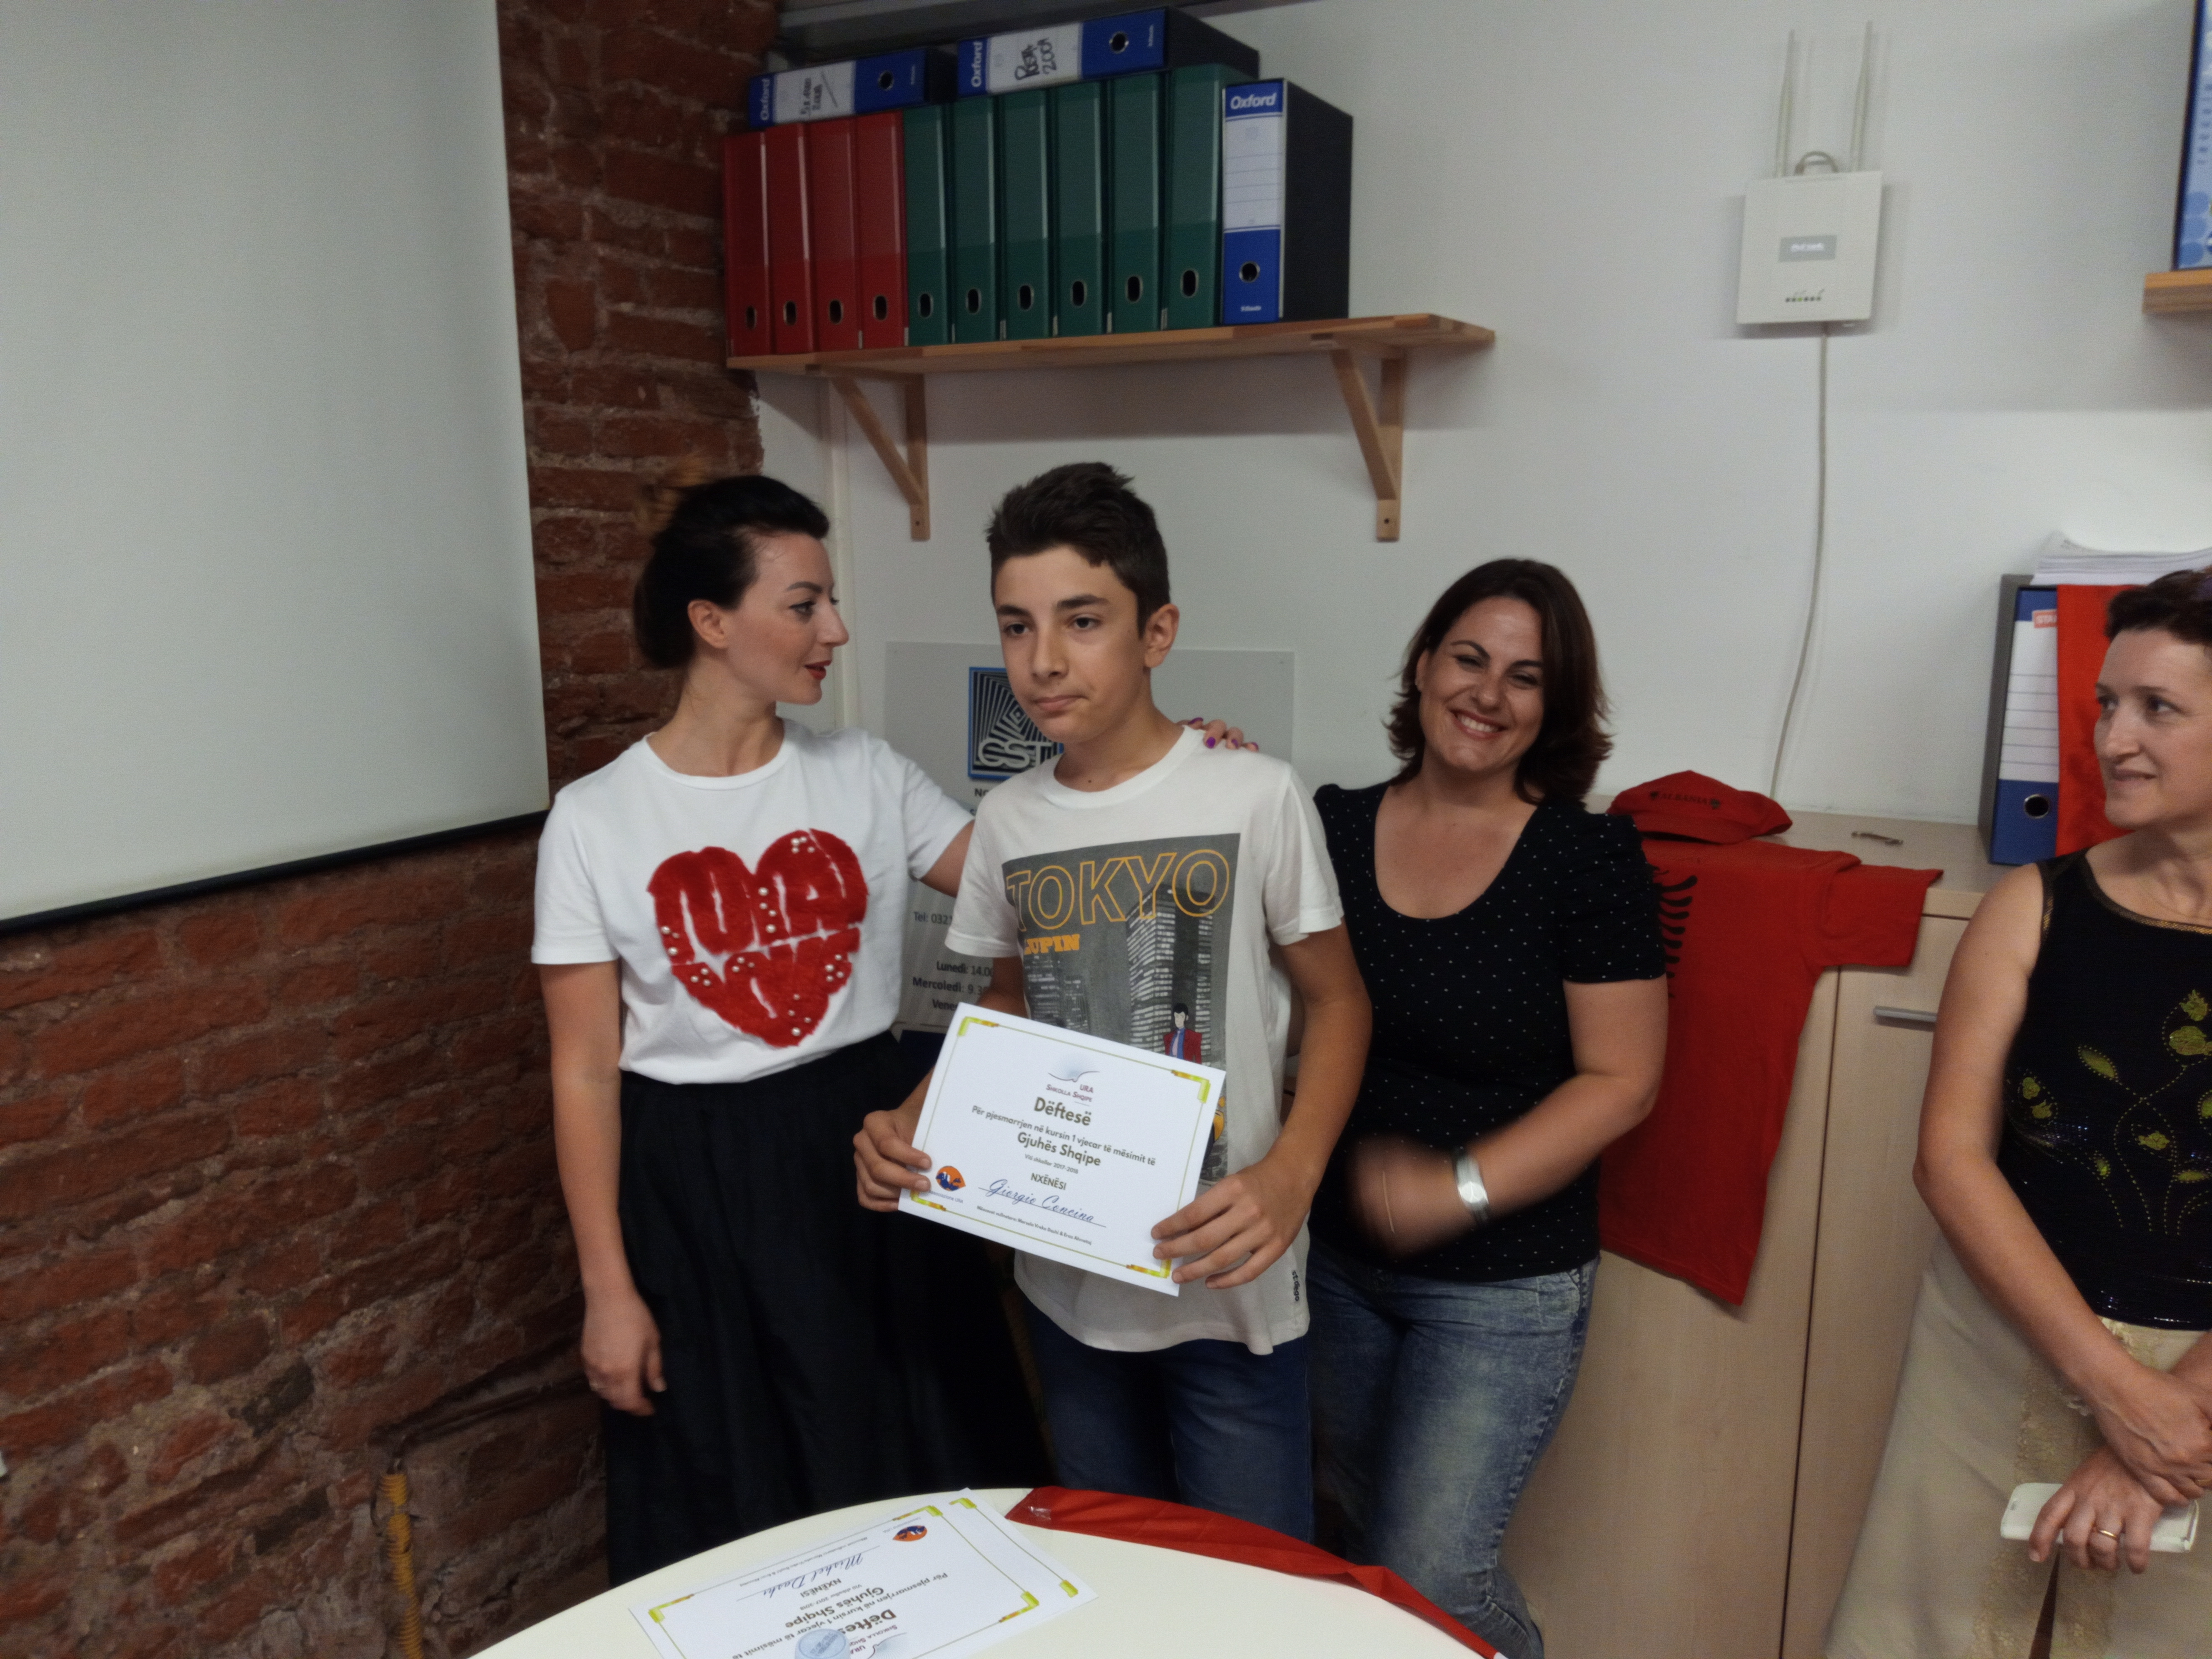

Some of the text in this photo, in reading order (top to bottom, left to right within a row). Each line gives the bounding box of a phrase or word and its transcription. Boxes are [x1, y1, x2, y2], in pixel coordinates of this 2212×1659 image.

[971, 41, 983, 87] Oxford
[760, 78, 770, 121] Oxford
[1230, 92, 1277, 110] Oxford
[1006, 849, 1230, 932] TOKYO
[914, 912, 929, 922] Tel:
[1024, 933, 1080, 955] LUPIN
[1080, 1084, 1093, 1093] URA
[1034, 1096, 1091, 1126] Dëftesë
[971, 1105, 985, 1115] Për
[986, 1111, 1032, 1129] pjesmarrjen
[1045, 1126, 1070, 1141] kursin
[1077, 1137, 1102, 1149] vjecar
[1104, 1144, 1112, 1153] të
[1113, 1148, 1146, 1163] mësimit
[1148, 1157, 1156, 1166] të
[1017, 1131, 1101, 1166] Gjuhës Shqipe
[1034, 1156, 1052, 1166] shkollor
[1053, 1162, 1079, 1174] 2017-2018
[1031, 1173, 1067, 1191] NXËNËSI
[985, 1179, 1094, 1223] Giorgio Concina
[811, 1553, 863, 1582] Mishel
[933, 1572, 948, 1581] Për
[763, 1575, 806, 1598] Dashi
[800, 1578, 842, 1598] NXËNËSI
[877, 1577, 931, 1603] pjesmarrjen
[785, 1587, 884, 1627] Gjuhës Shqipe
[833, 1606, 863, 1620] kursin
[864, 1601, 875, 1609] në
[797, 1621, 825, 1635] vjecar
[838, 1609, 897, 1635] Dëftes
[744, 1637, 782, 1656] mësimit
